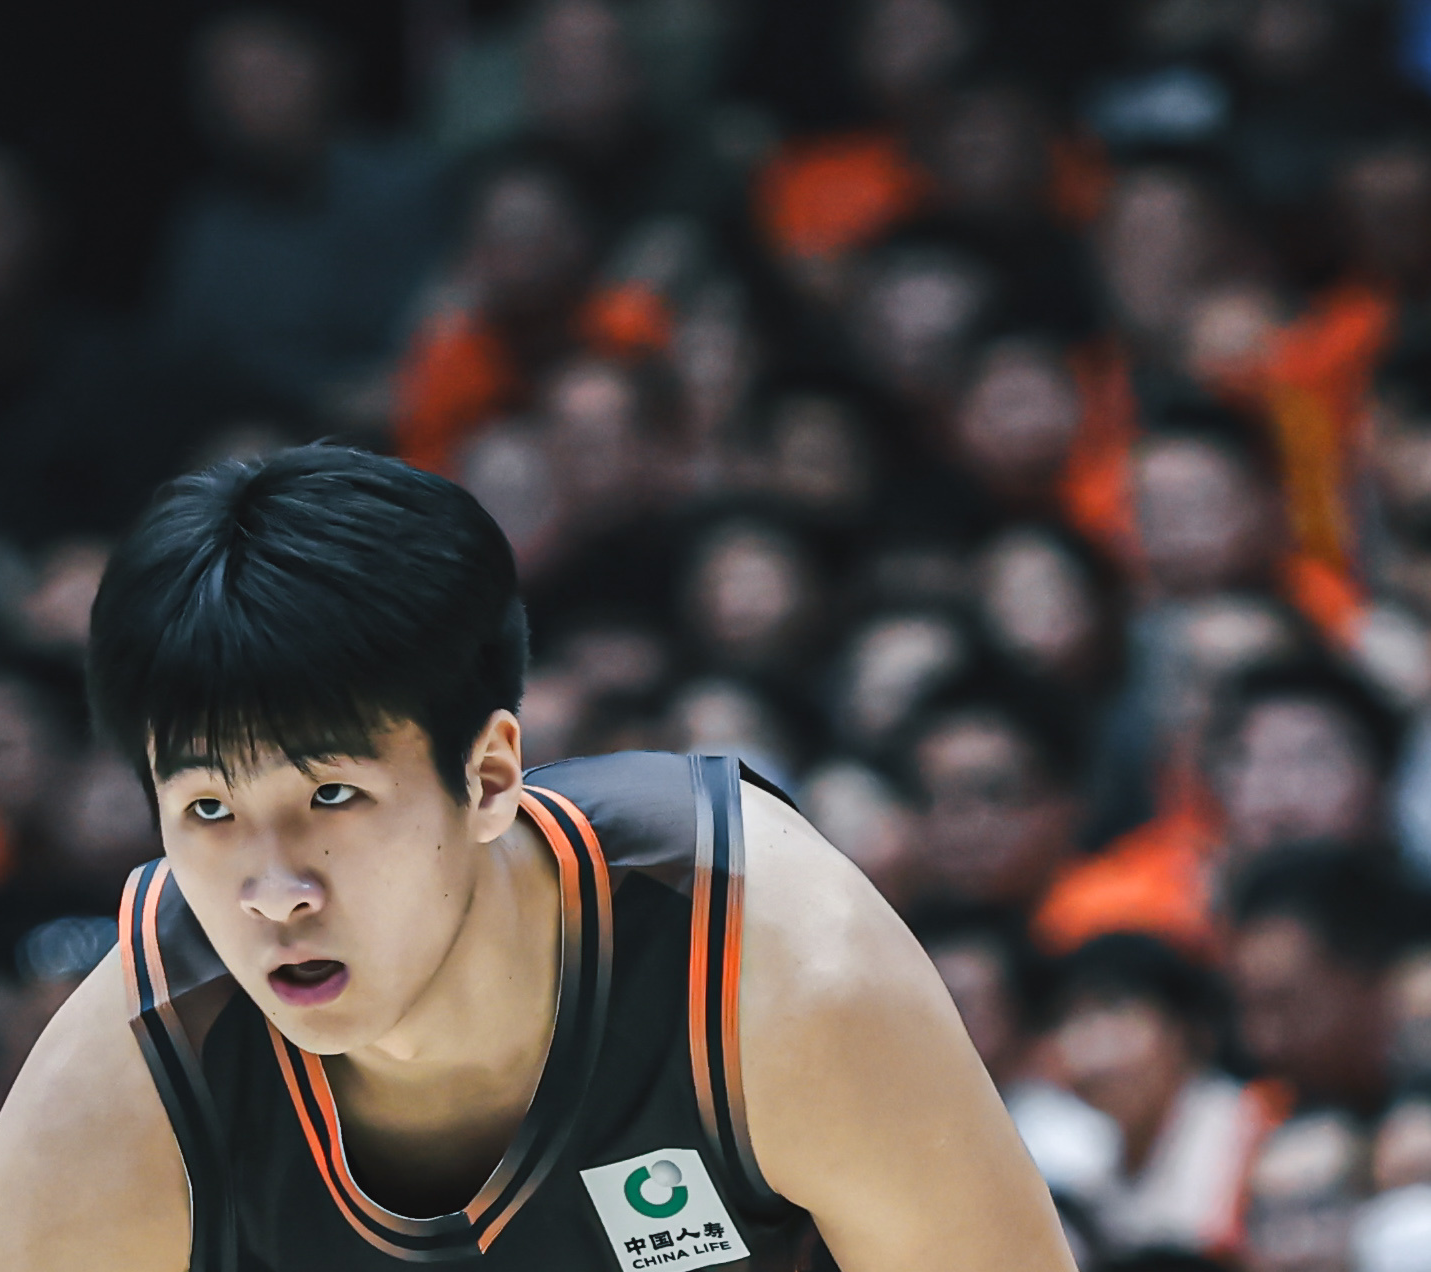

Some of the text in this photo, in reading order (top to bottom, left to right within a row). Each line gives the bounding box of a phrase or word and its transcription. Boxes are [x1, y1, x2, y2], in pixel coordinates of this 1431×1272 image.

[624, 1222, 725, 1256] 中国人寿
[632, 1240, 732, 1269] CHINA LIFE
